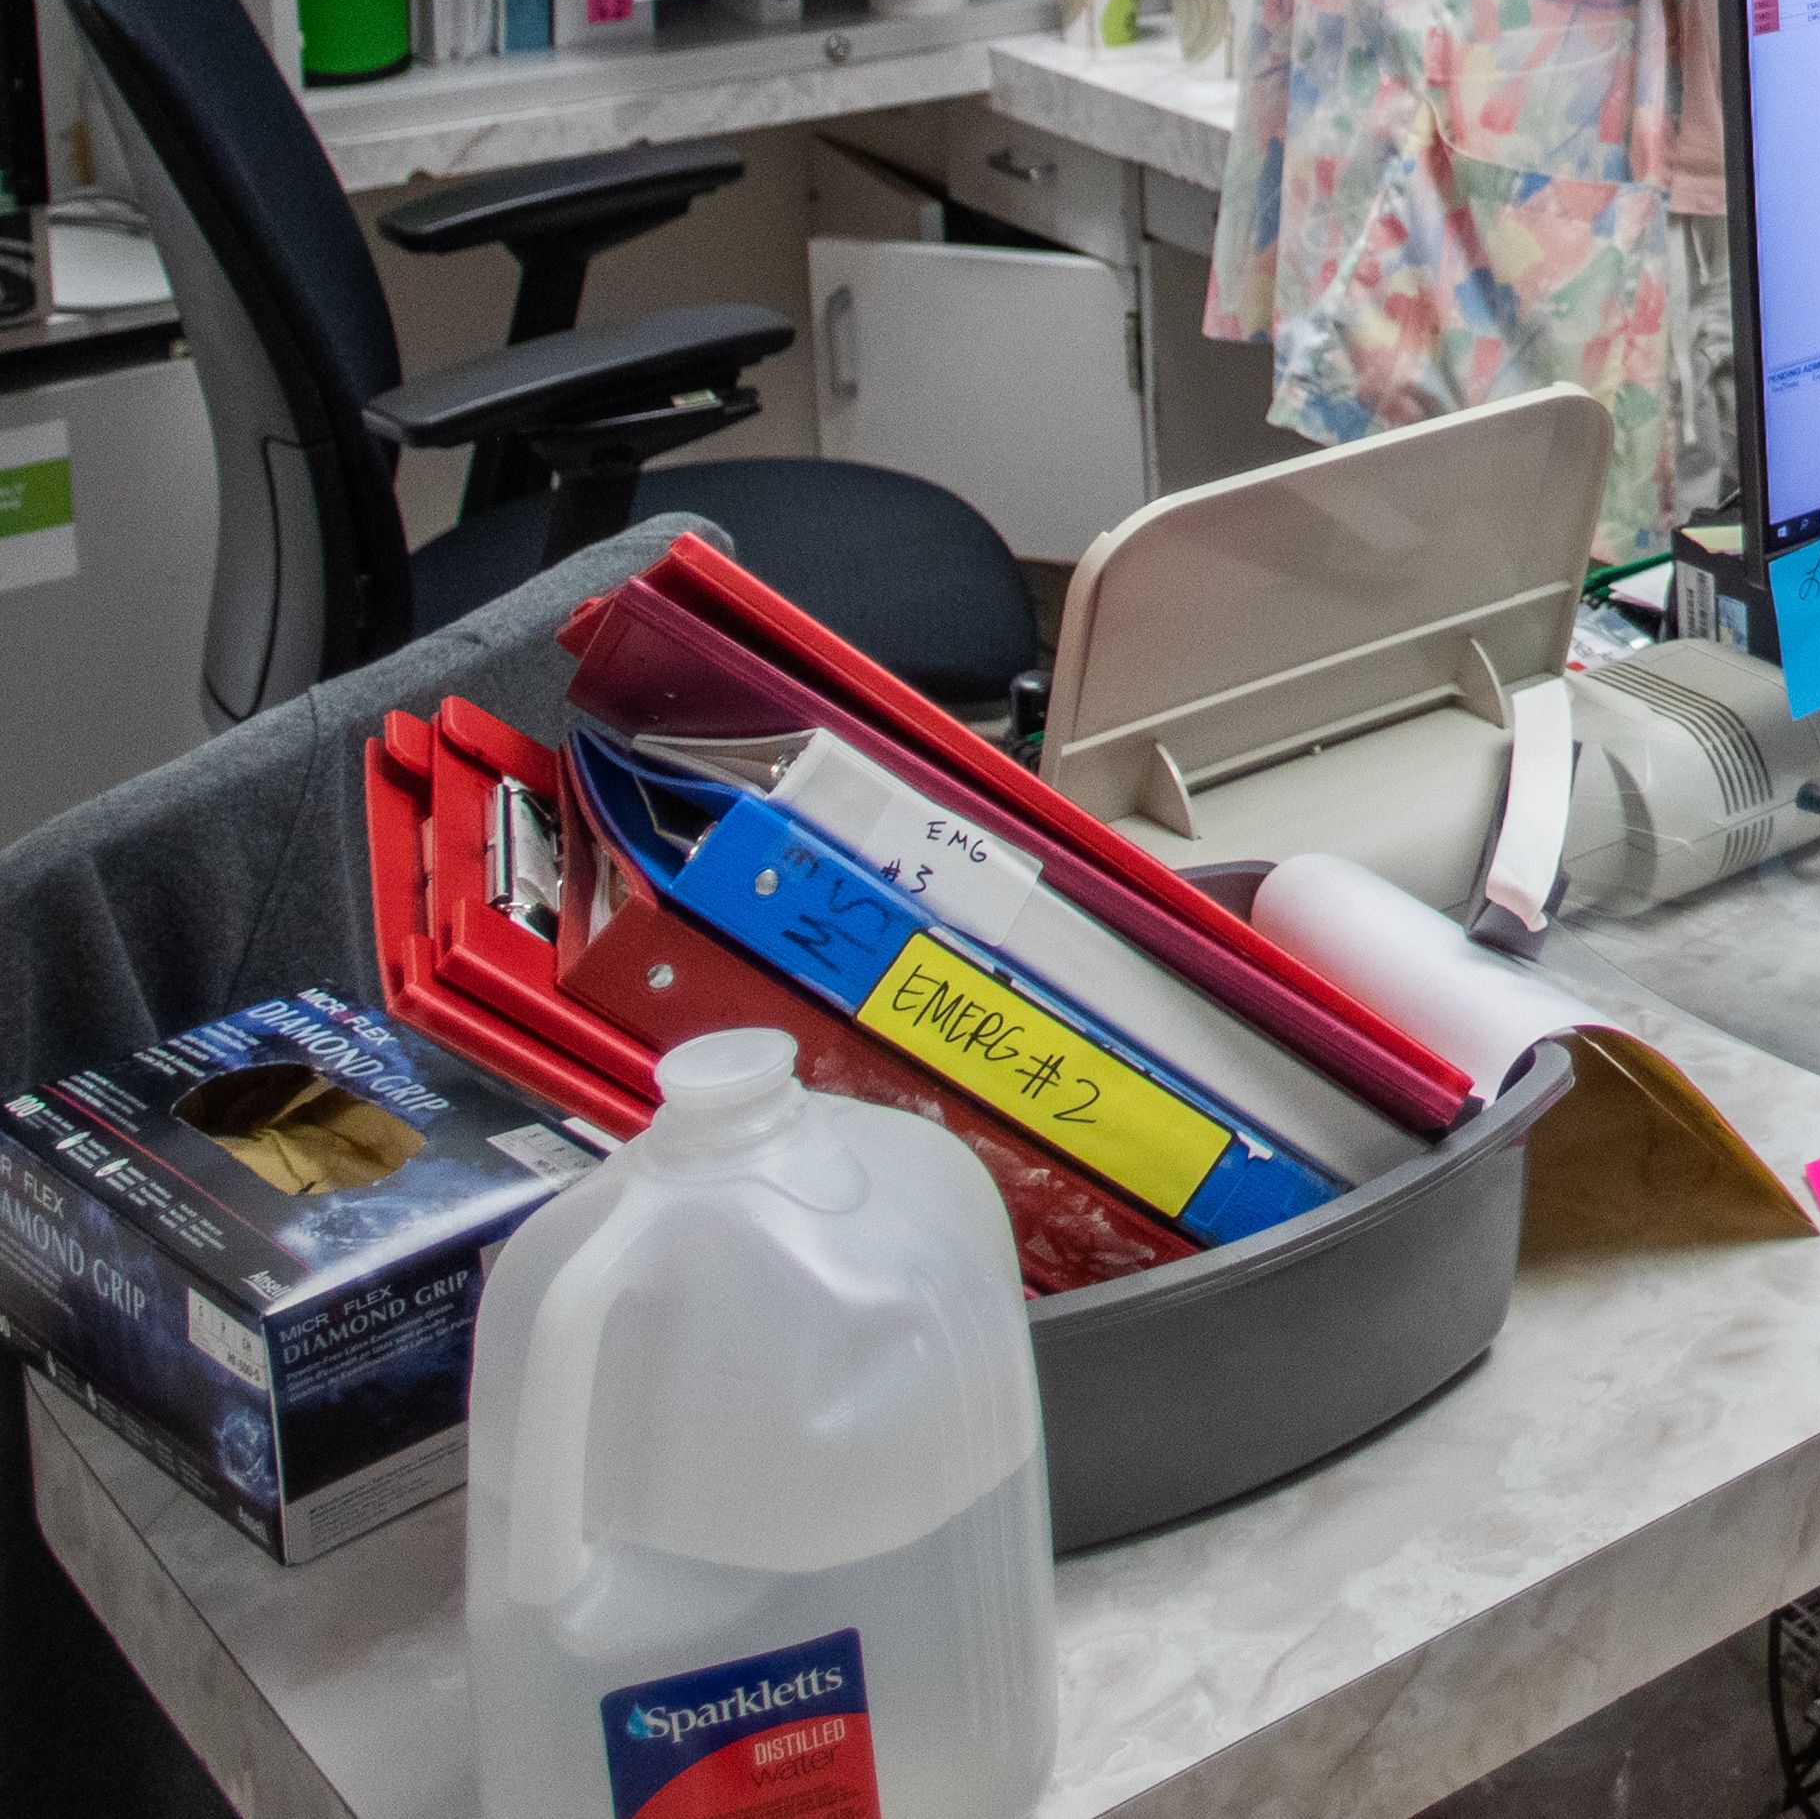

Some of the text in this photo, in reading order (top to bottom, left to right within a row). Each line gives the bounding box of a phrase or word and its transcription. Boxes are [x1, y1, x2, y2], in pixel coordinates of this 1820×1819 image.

[925, 820, 988, 865] EMG
[892, 963, 1025, 1062] EMERG
[247, 999, 385, 1078] DIAMOND
[369, 1075, 451, 1112] GRIP
[93, 1258, 146, 1321] GRIP
[278, 1283, 393, 1343] MICRFLEX
[283, 1269, 469, 1364] DIAMOND GRIP
[643, 1665, 844, 1745] Sparkletts
[750, 1746, 837, 1789] Water
[753, 1717, 847, 1767] DISTILLED
